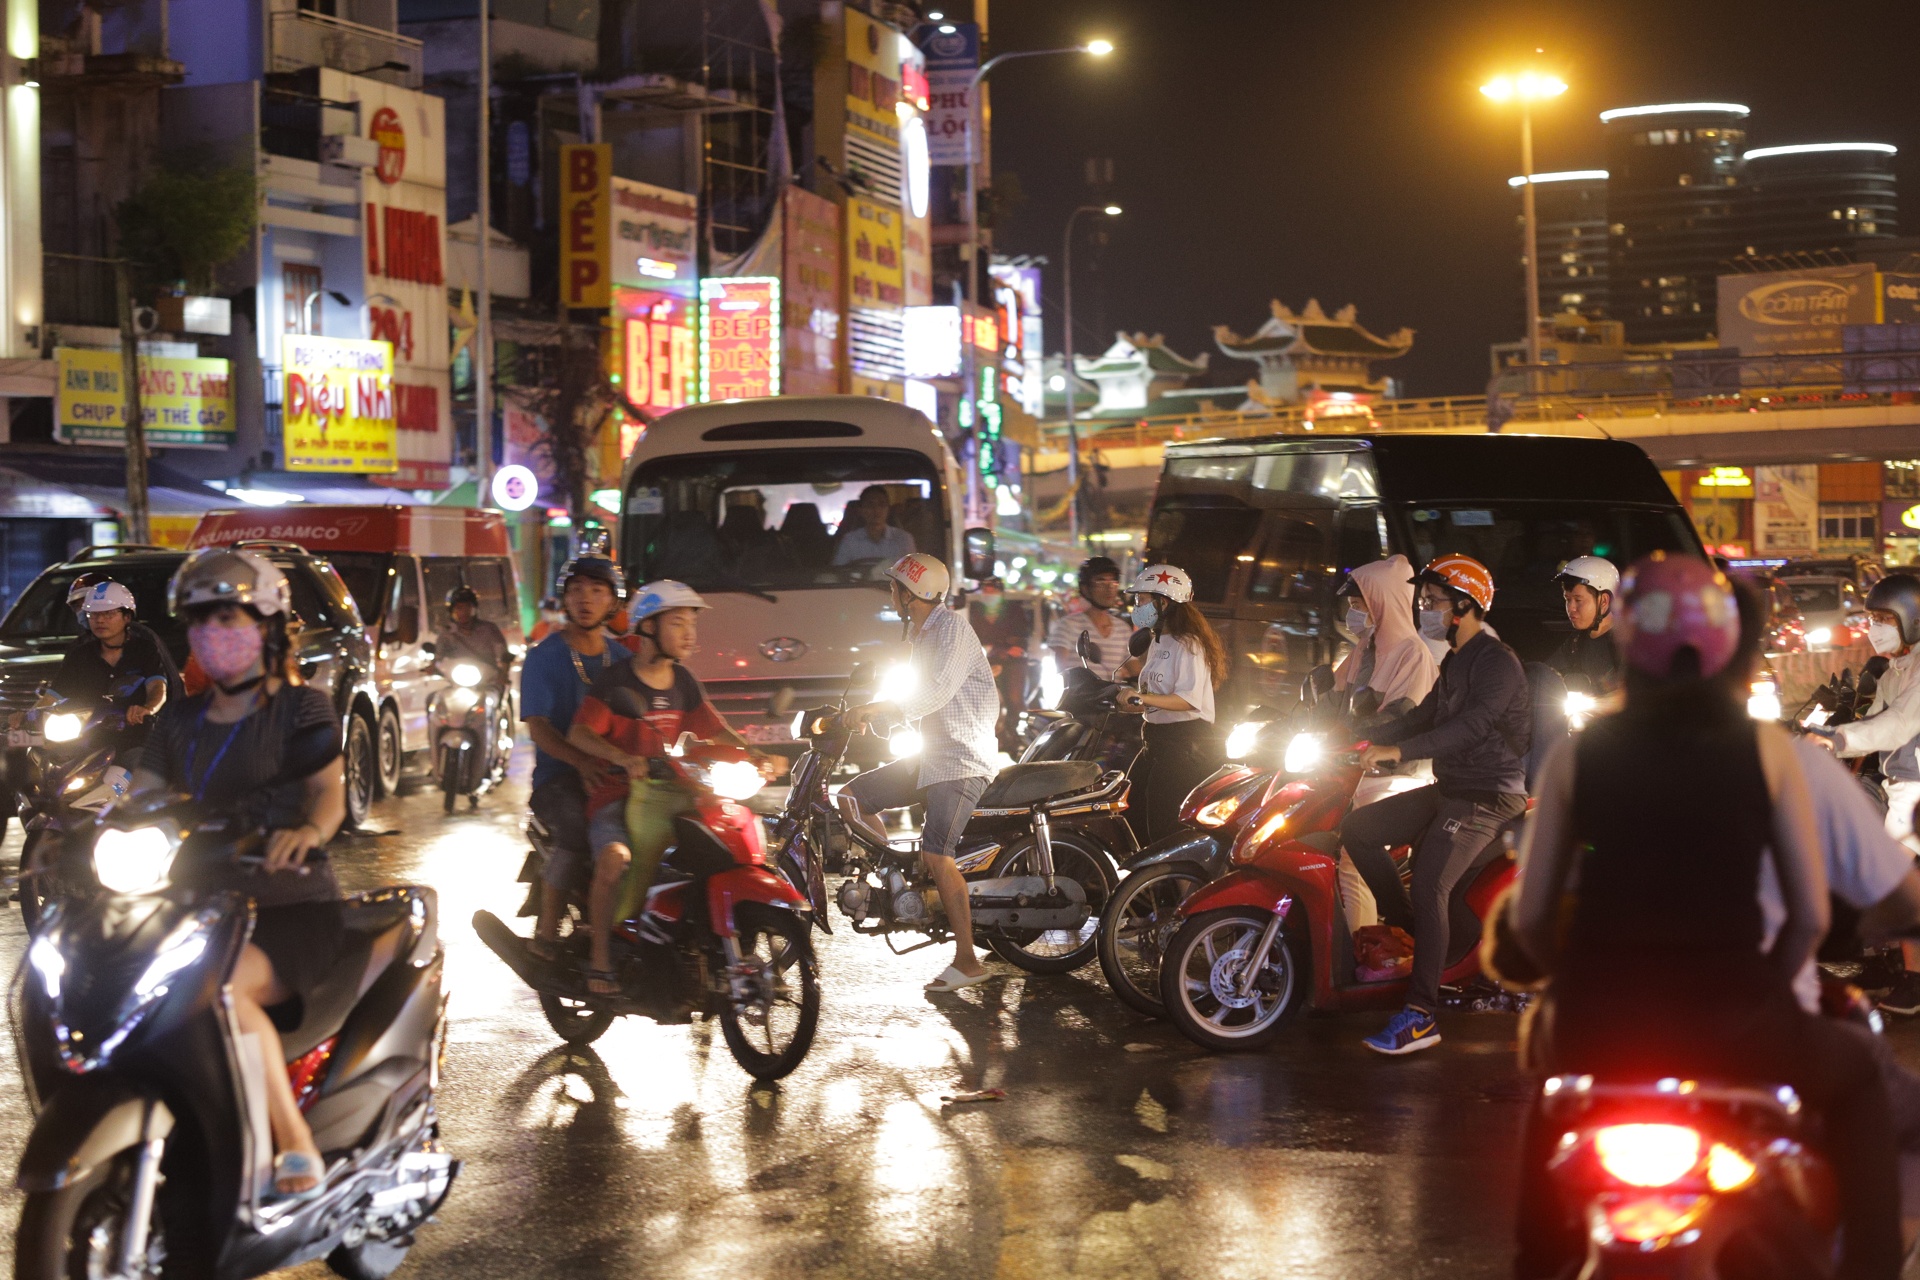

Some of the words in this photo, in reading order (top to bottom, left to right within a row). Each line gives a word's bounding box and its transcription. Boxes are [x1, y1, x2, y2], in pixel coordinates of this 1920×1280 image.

[571, 150, 599, 302] BẾP
[711, 311, 771, 340] BẾP
[626, 299, 694, 409] BẾP
[199, 526, 266, 545] KUMHO
[269, 526, 341, 540] SAMCO
[1299, 862, 1327, 871] HONDA
